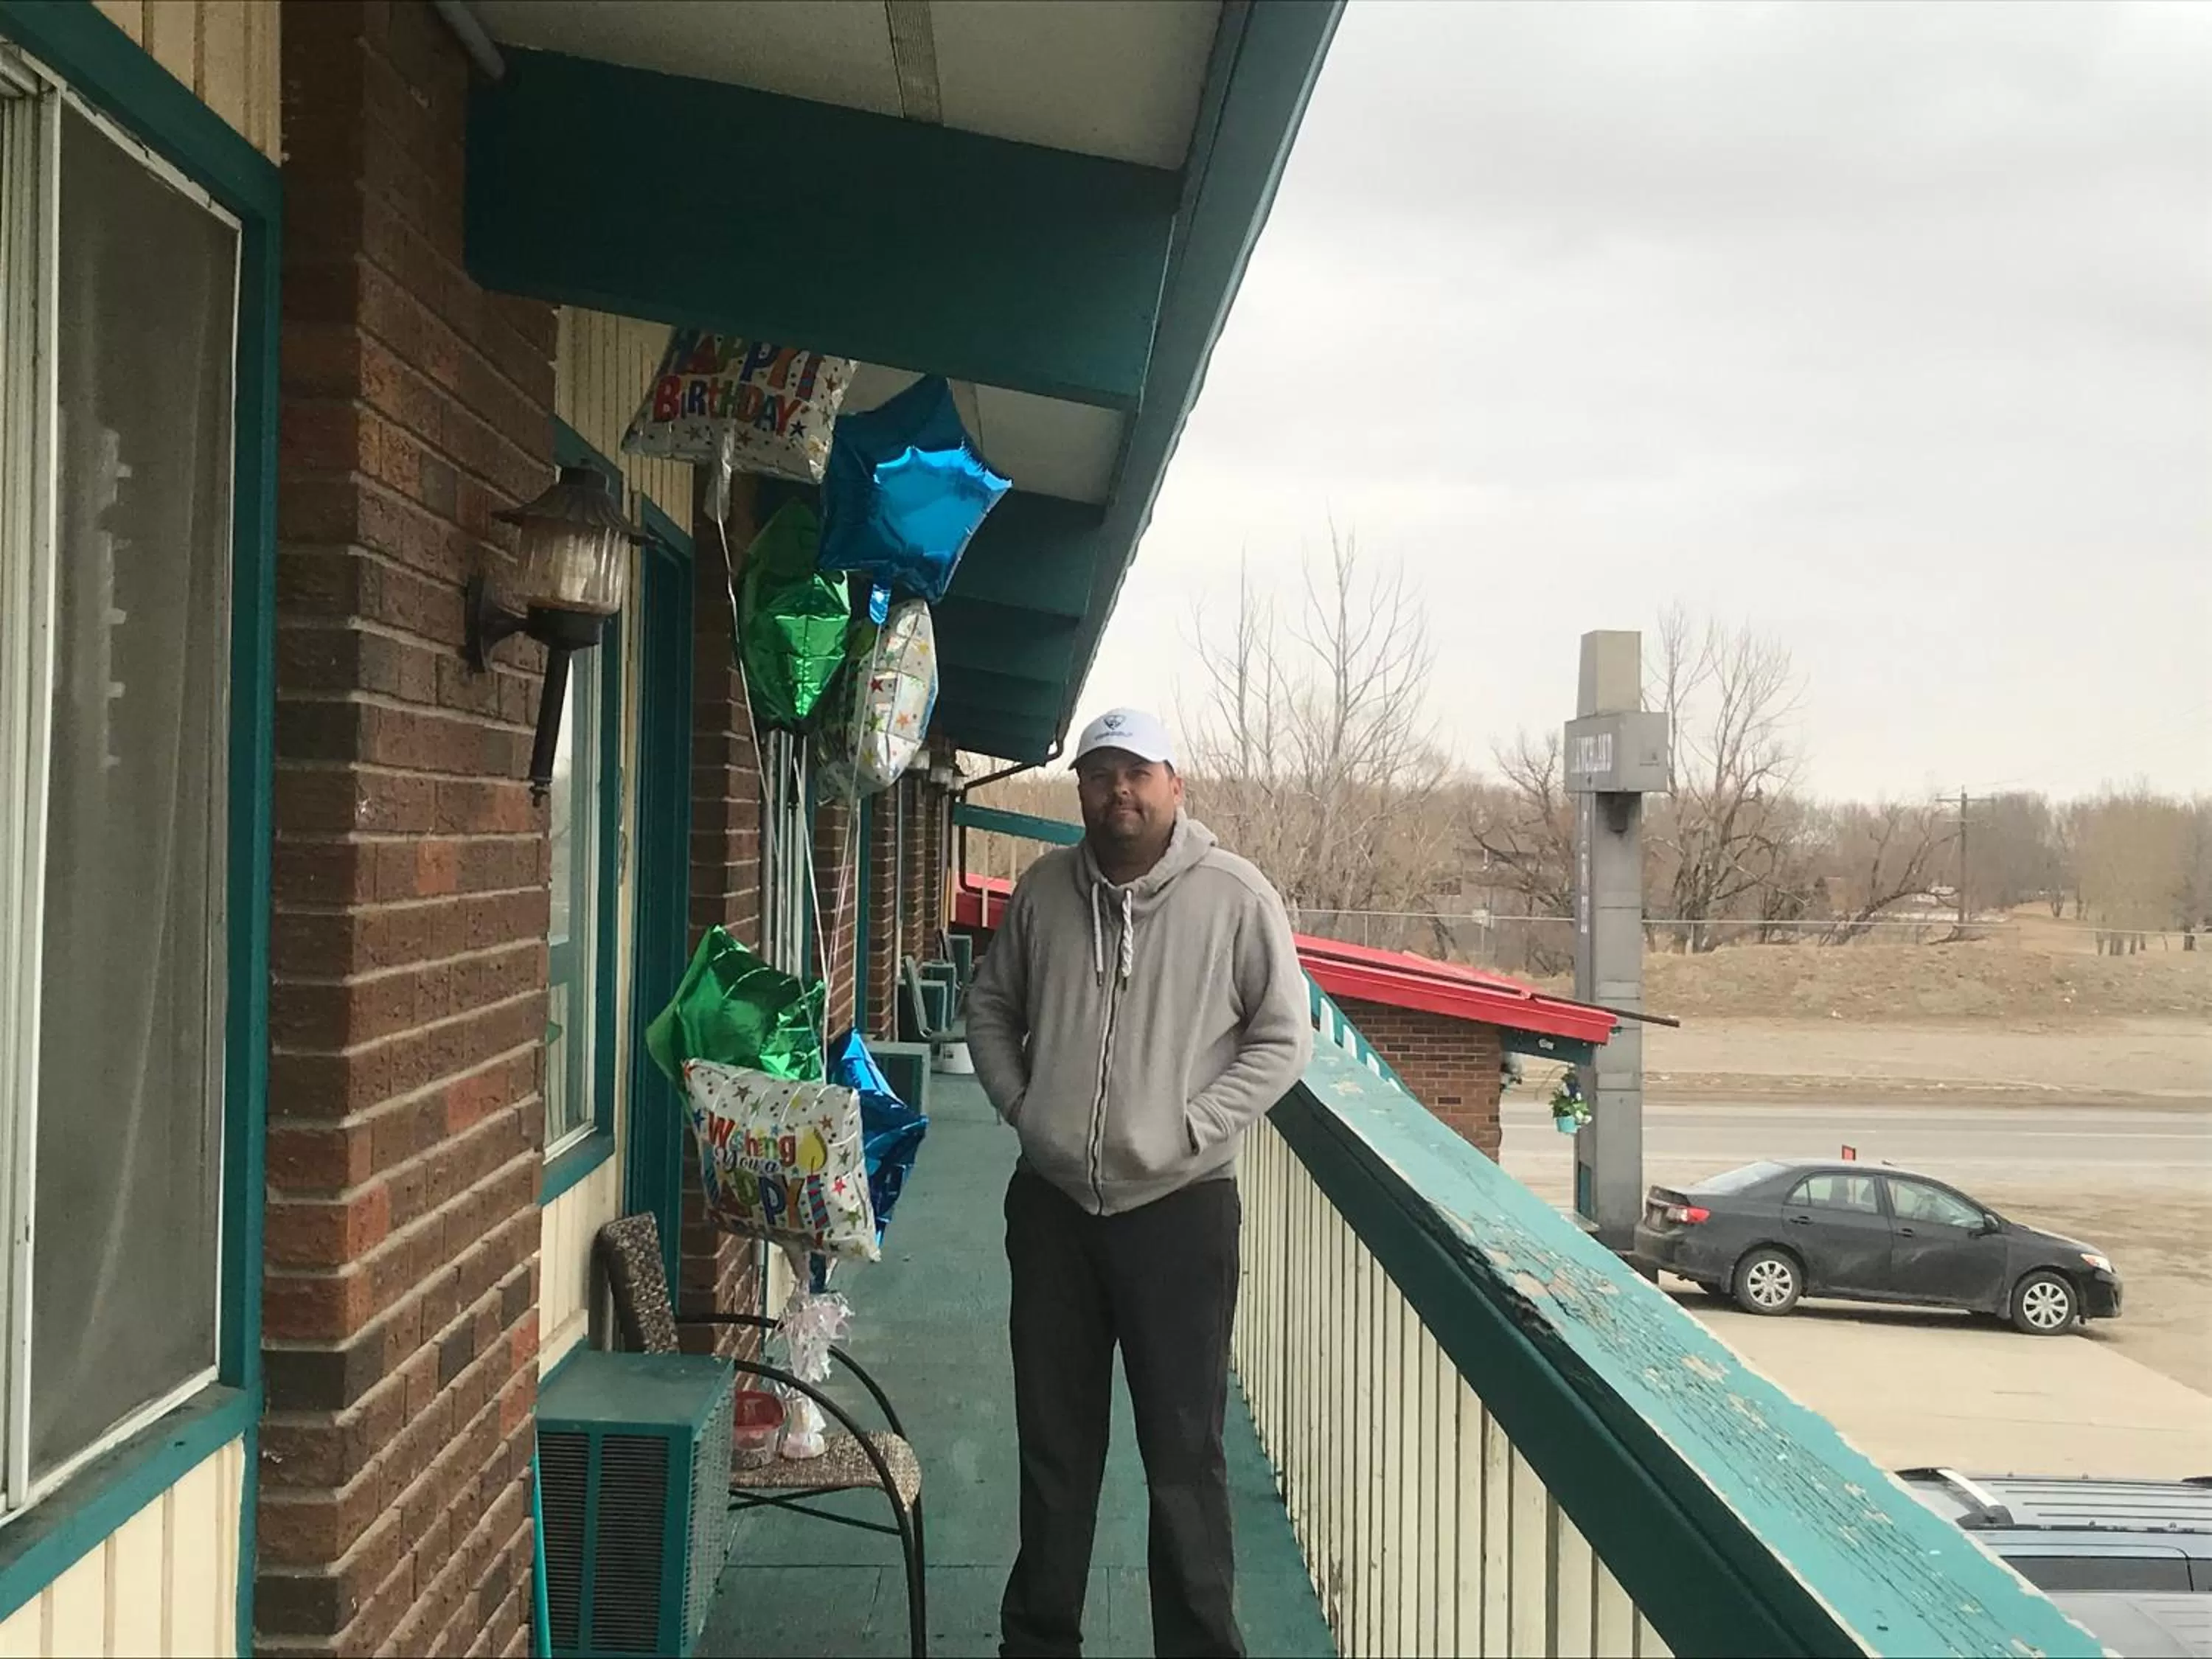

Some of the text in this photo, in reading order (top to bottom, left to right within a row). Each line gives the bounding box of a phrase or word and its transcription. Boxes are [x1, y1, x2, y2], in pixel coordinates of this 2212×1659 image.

[653, 374, 803, 437] BIRTHDAY
[708, 1111, 796, 1167] Wshing
[714, 1147, 759, 1173] You
